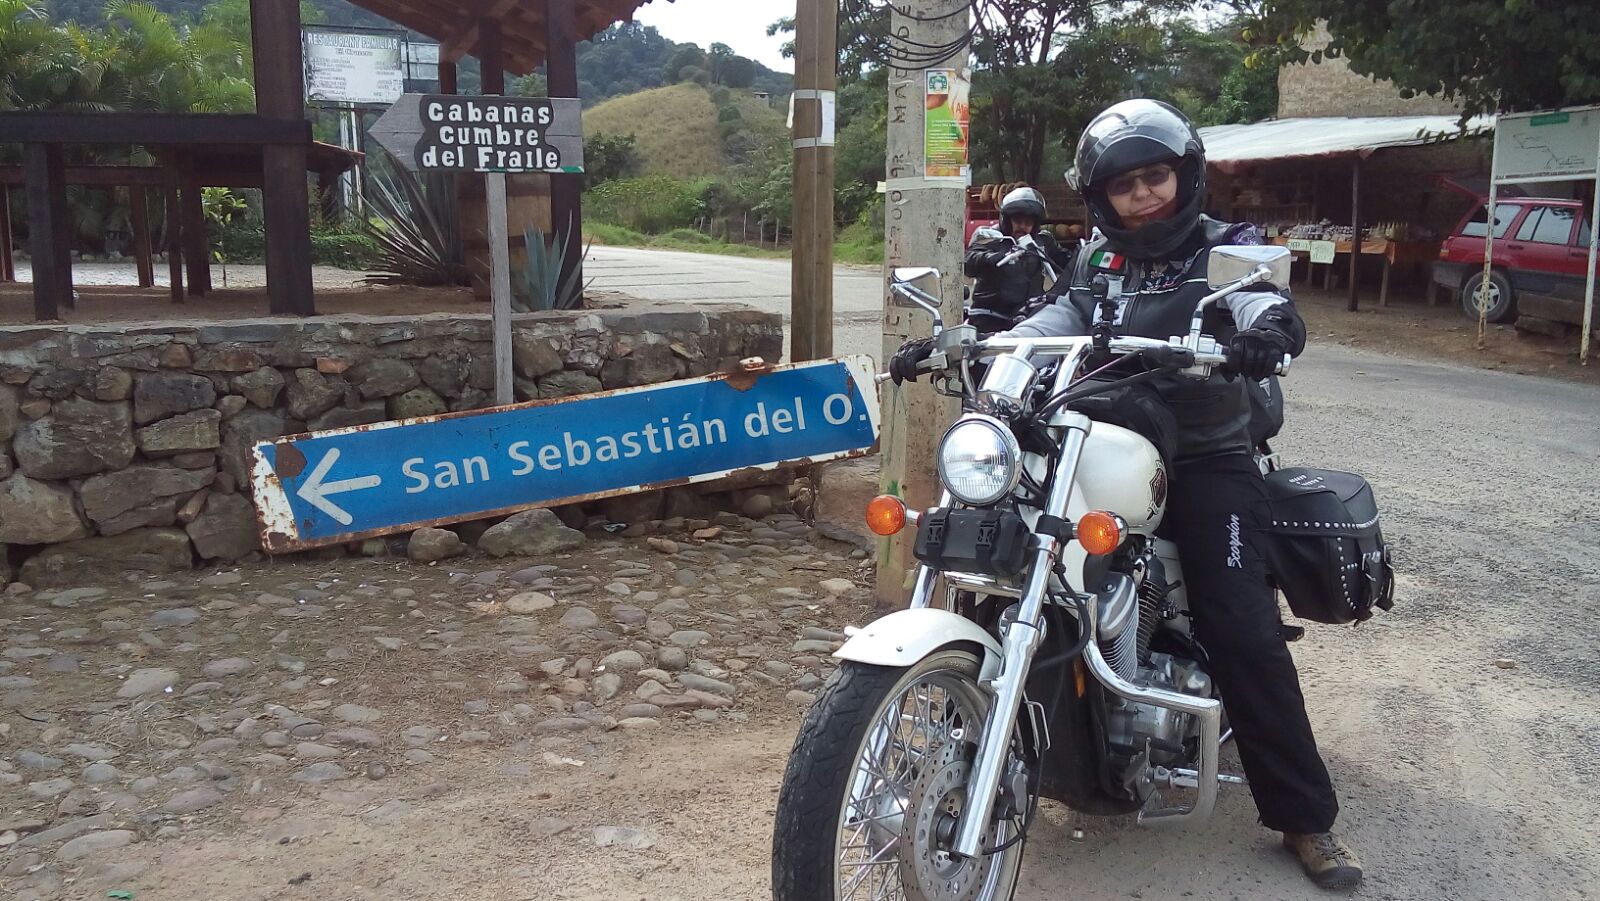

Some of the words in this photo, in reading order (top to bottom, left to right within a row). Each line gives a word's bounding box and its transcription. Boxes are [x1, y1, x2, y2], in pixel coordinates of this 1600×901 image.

[362, 36, 398, 50] FAMILIAR
[421, 146, 465, 168] del
[477, 146, 558, 169] Fraile
[401, 454, 491, 494] San
[507, 411, 728, 476] Sebastián
[743, 396, 807, 438] del
[822, 393, 867, 426] O.
[1226, 513, 1244, 569] Scorpion
